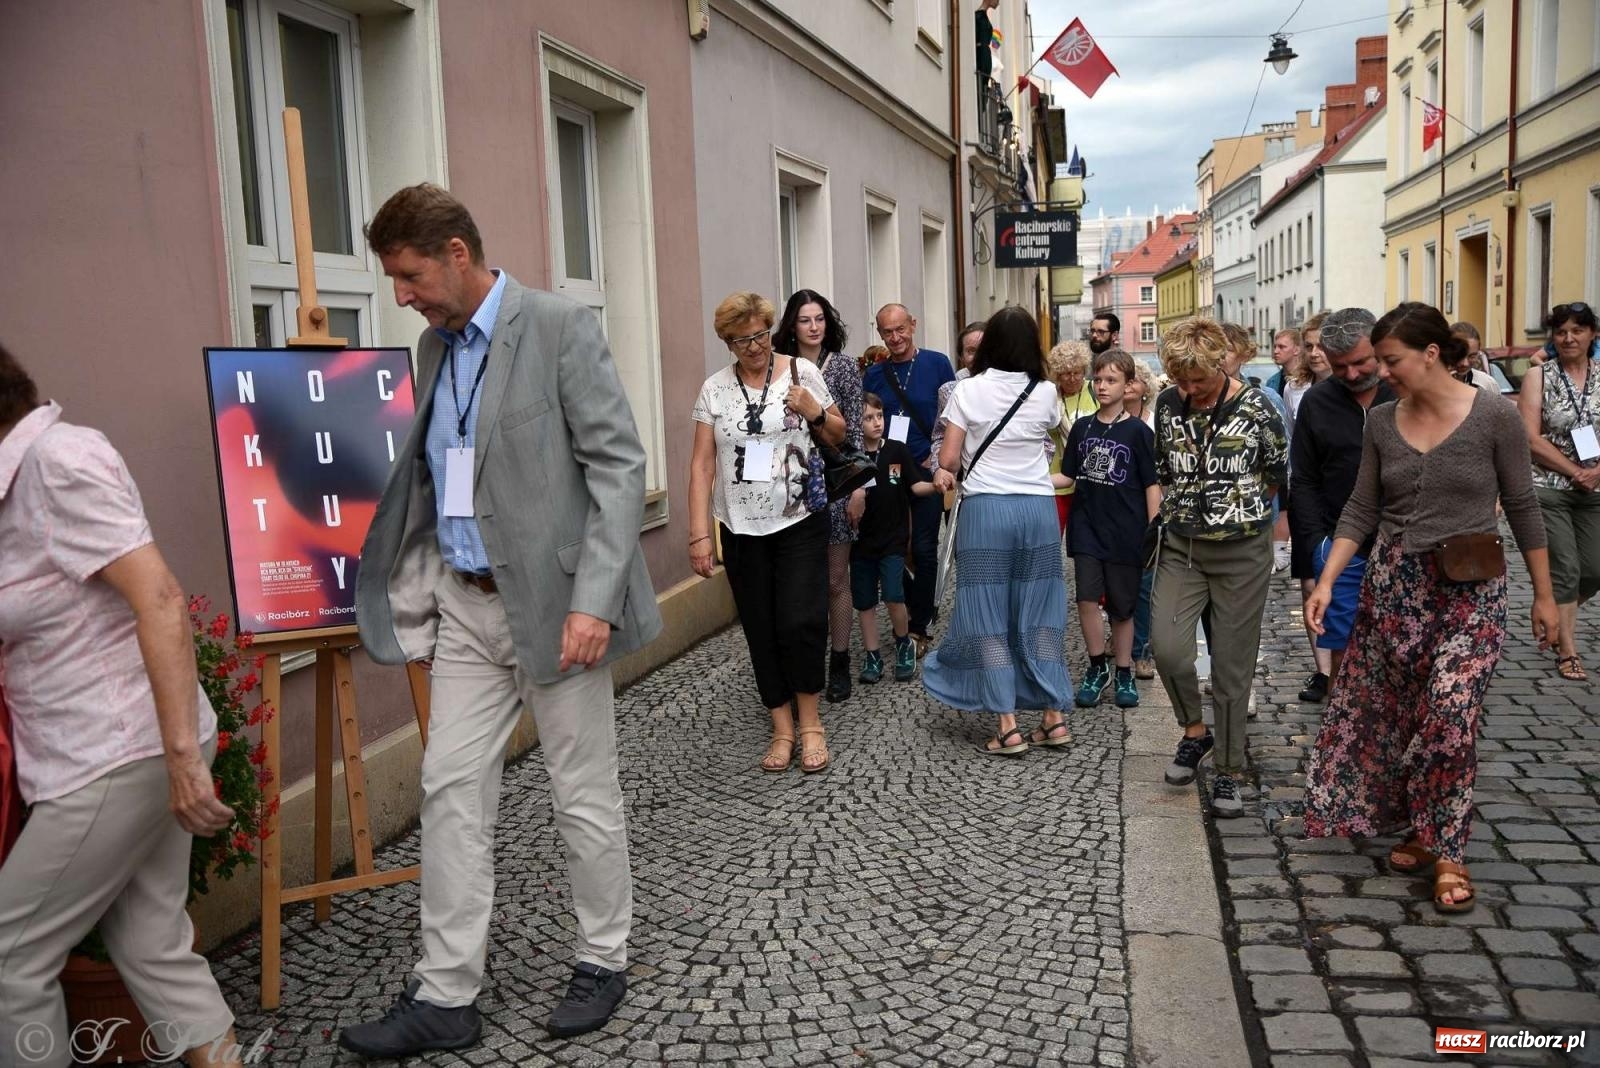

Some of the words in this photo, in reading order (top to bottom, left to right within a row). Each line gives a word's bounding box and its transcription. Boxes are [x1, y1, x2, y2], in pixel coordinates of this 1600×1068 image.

[1014, 220, 1071, 233] Raciborskie
[1015, 246, 1050, 260] Kultury
[268, 609, 310, 620] Racibórz
